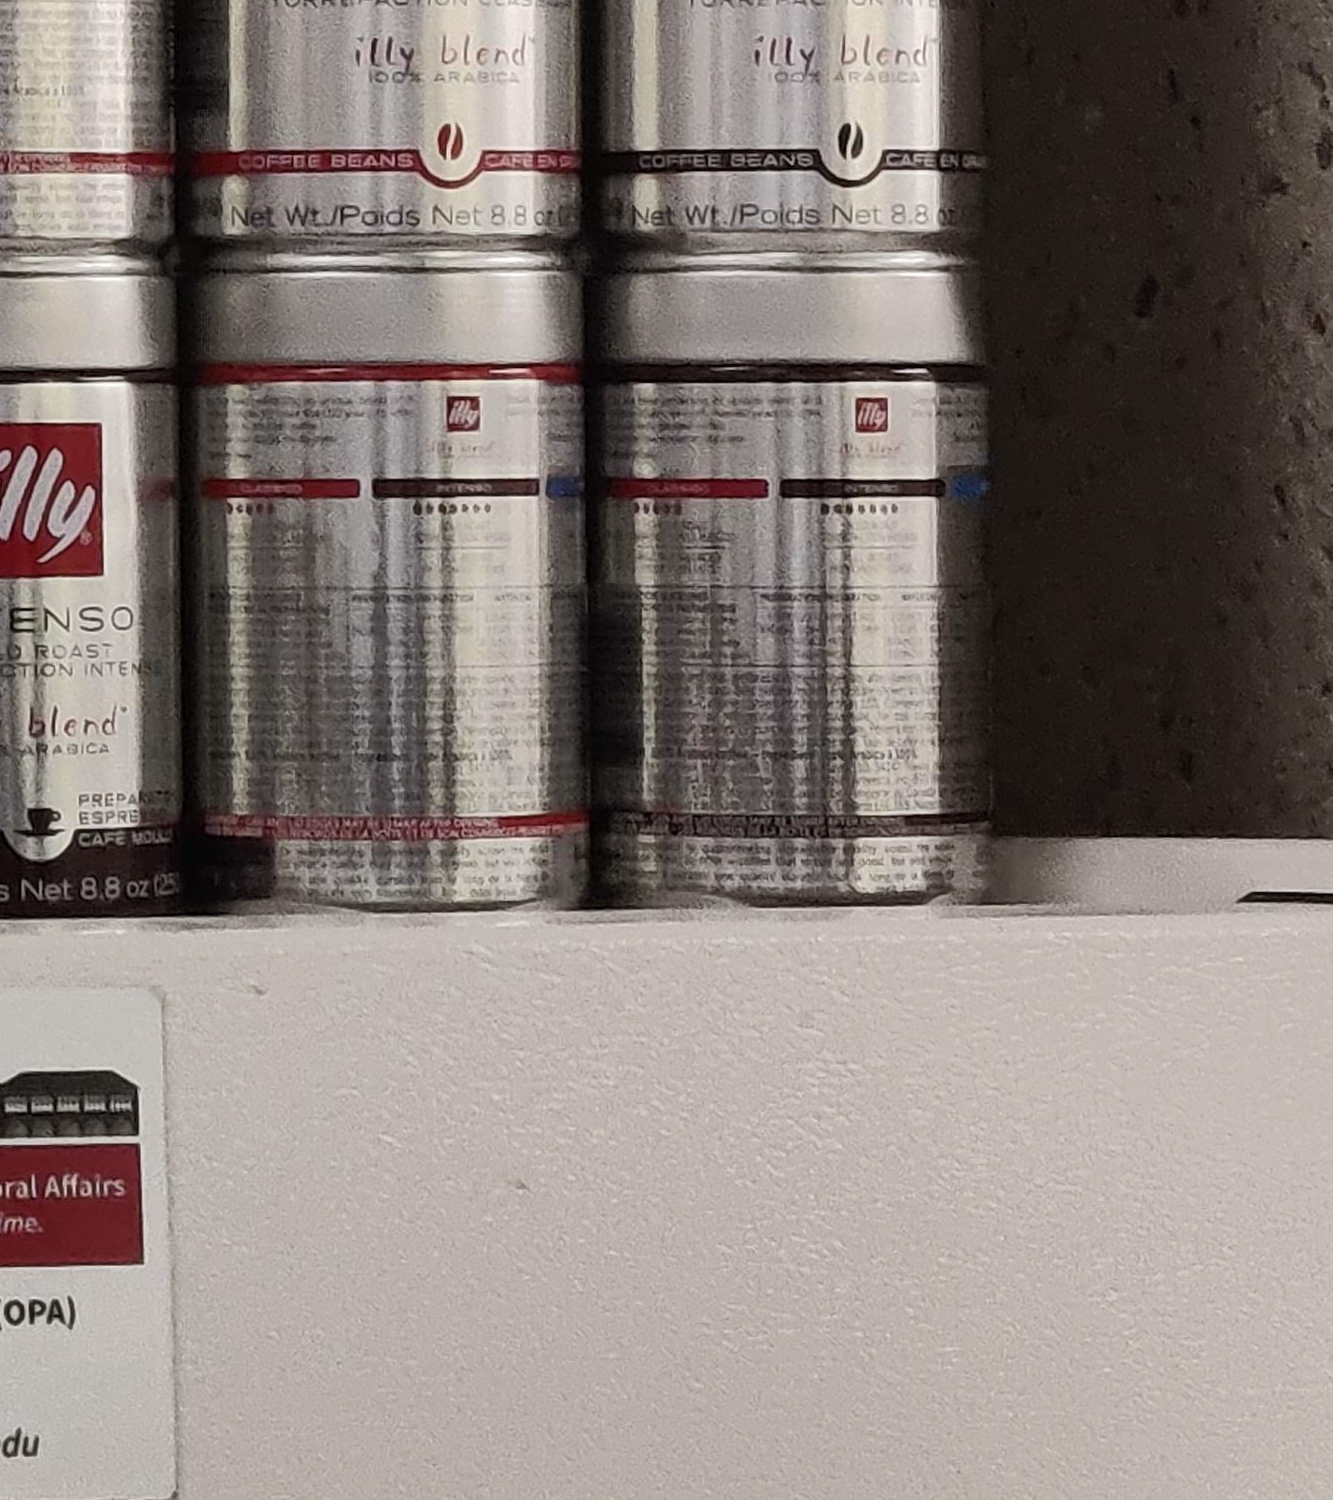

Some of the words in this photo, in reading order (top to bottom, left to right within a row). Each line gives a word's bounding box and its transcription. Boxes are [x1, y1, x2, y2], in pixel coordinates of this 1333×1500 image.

[356, 36, 414, 72] illy
[731, 153, 814, 166] BEANS
[832, 203, 882, 225] Net
[891, 204, 929, 224] 8.8
[34, 643, 113, 659] ROAST
[20, 878, 72, 900] Net
[80, 877, 120, 899] 8.8
[127, 879, 148, 898] oz
[44, 1174, 125, 1198] Affairs
